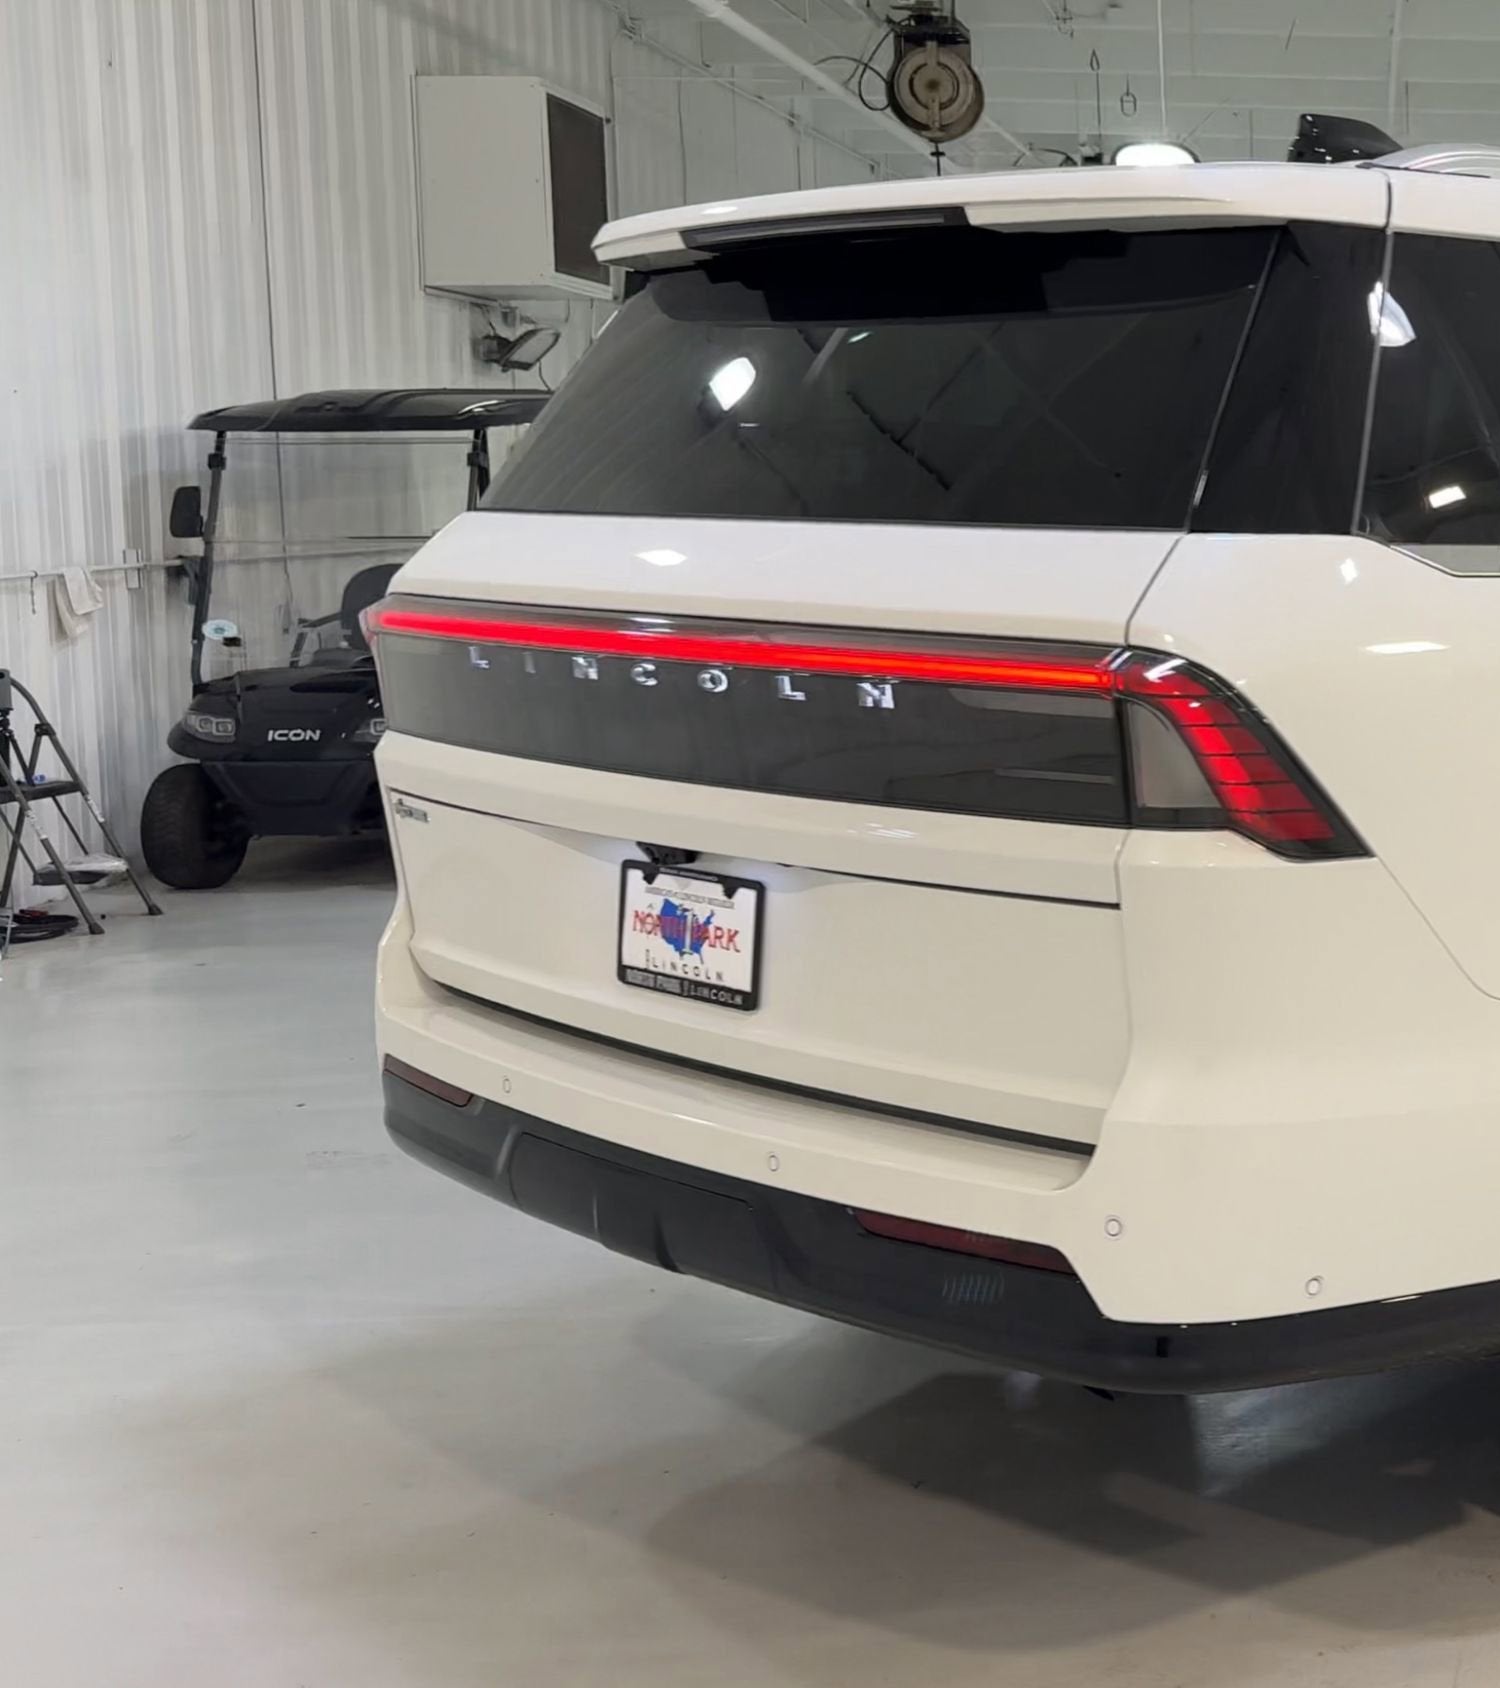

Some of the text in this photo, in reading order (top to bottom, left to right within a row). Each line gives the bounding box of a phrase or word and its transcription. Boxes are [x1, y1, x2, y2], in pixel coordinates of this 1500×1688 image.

[466, 645, 897, 710] LINCOLN
[267, 728, 321, 742] ICON
[652, 956, 725, 982] LINCOLN
[690, 983, 744, 1006] LINCOLN
